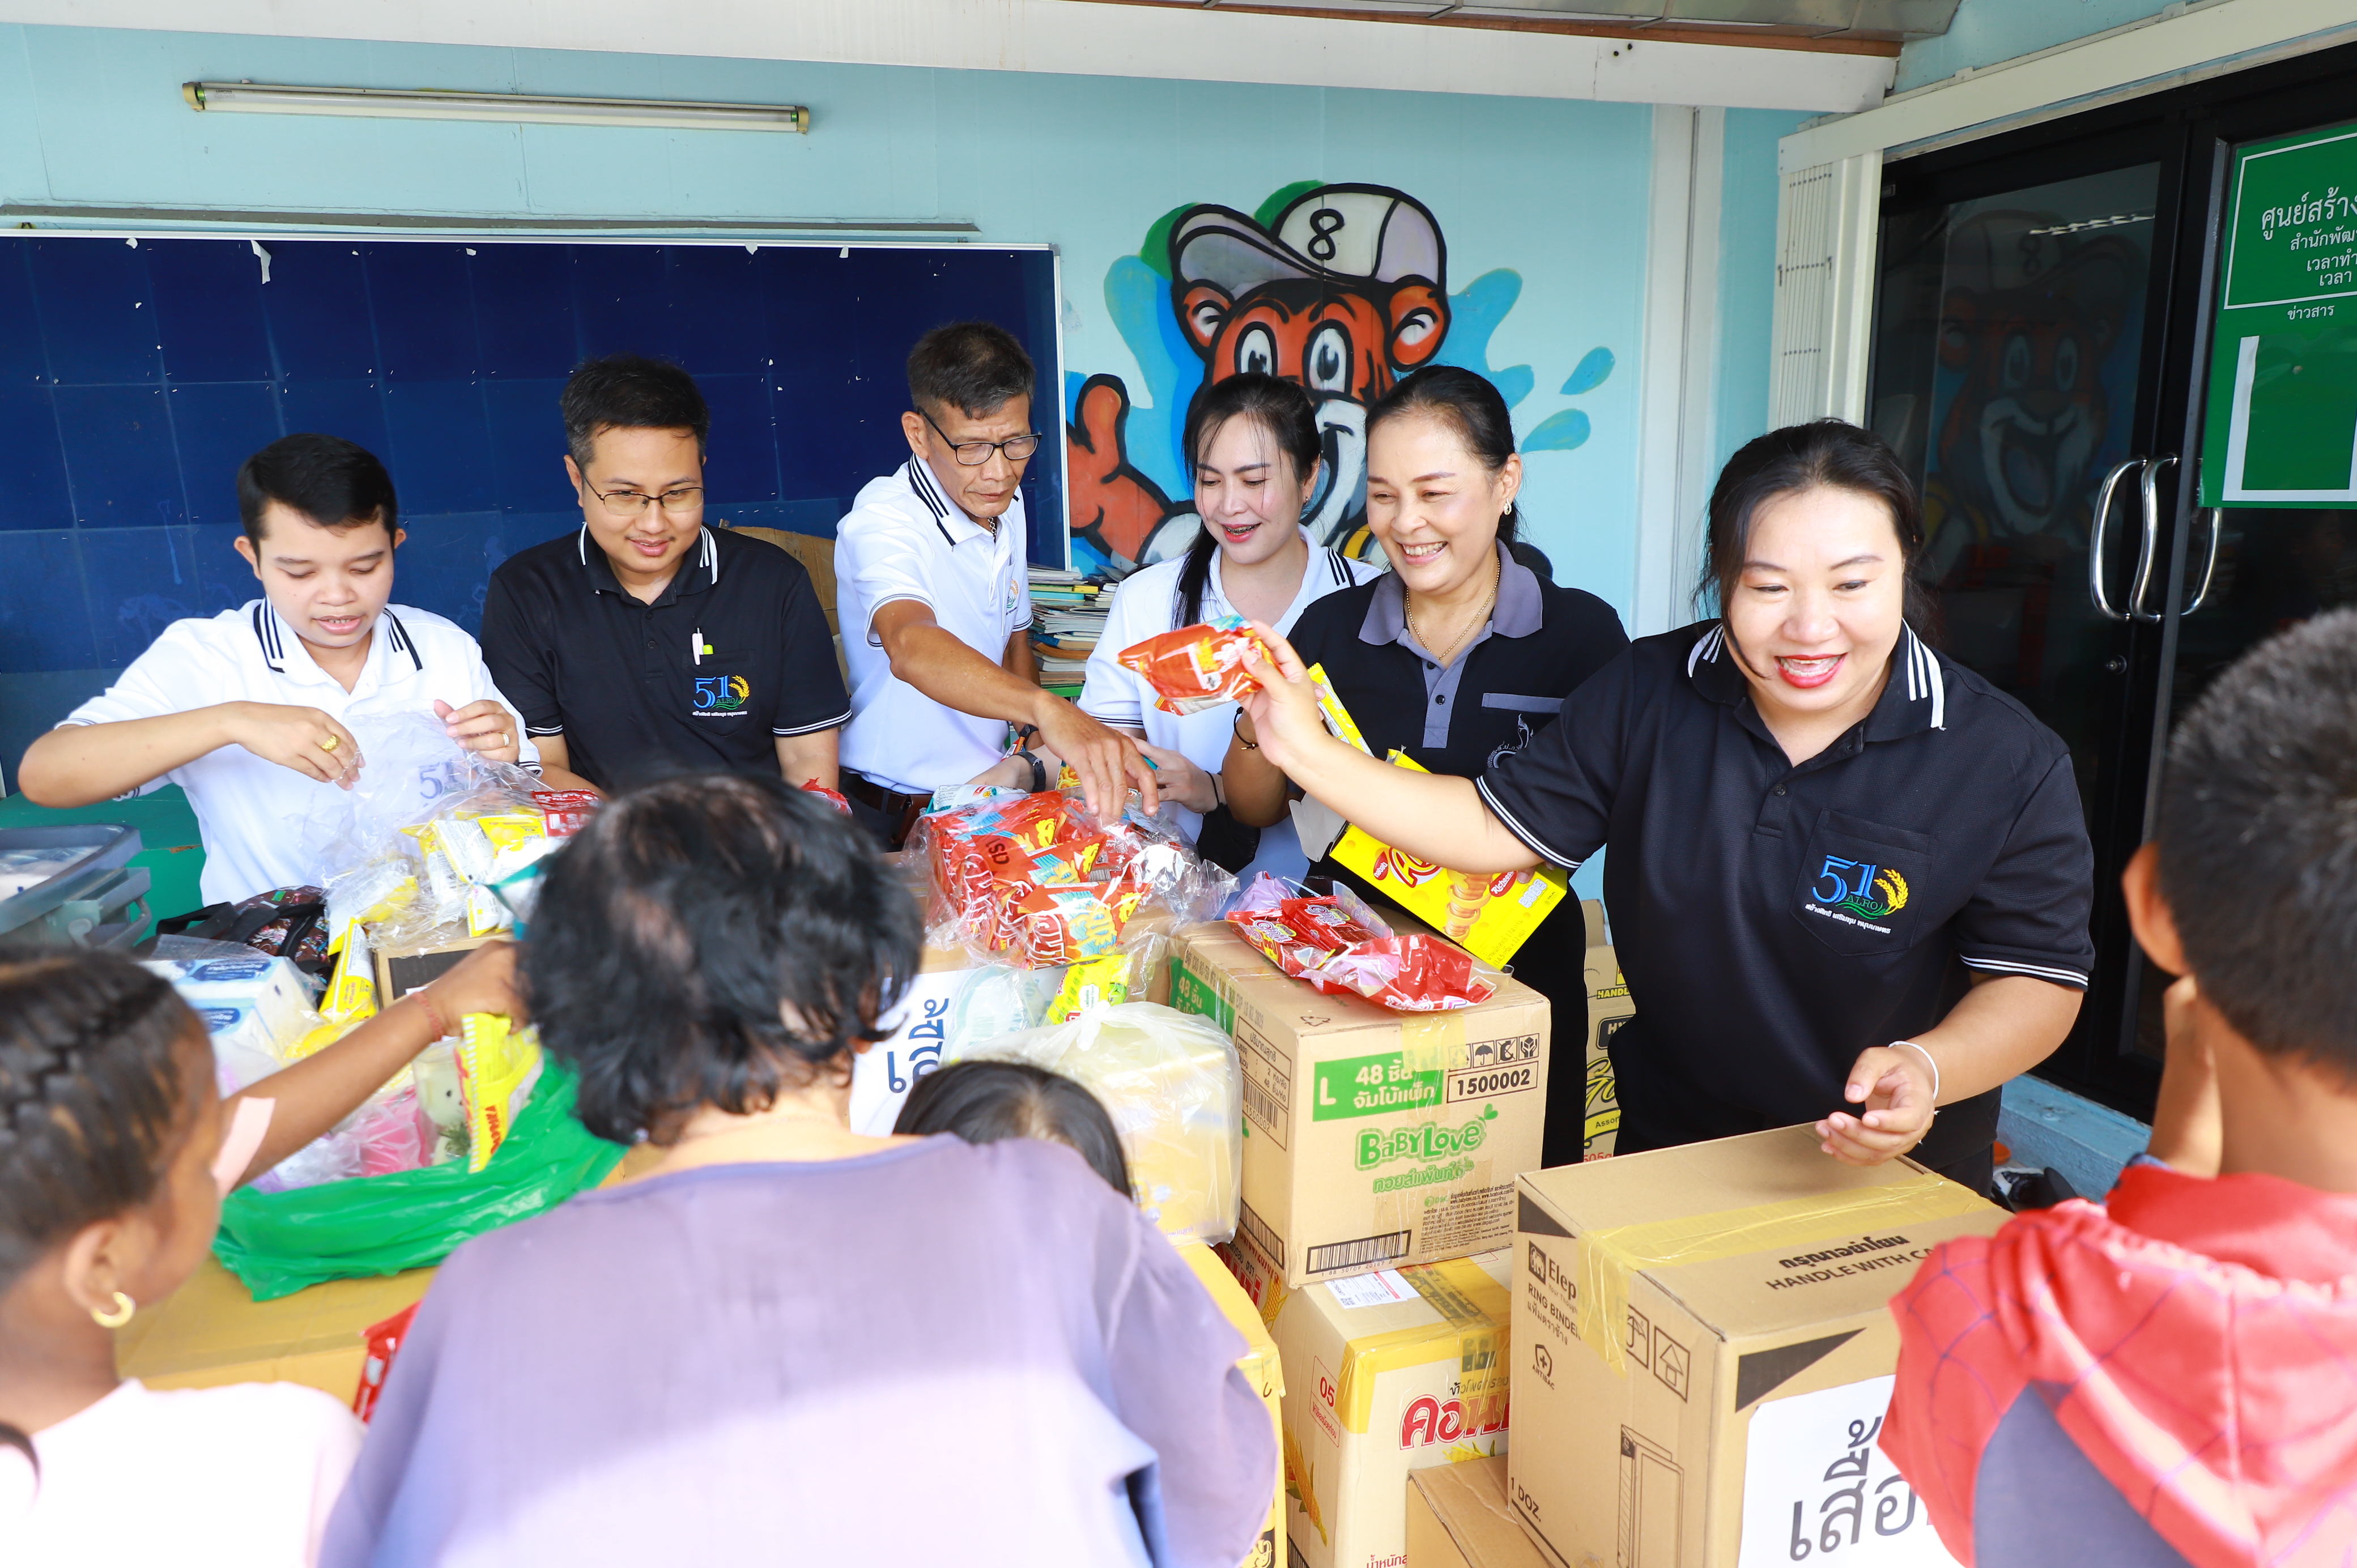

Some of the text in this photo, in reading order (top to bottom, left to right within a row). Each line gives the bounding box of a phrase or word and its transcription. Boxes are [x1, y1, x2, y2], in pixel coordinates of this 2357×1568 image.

[1308, 208, 1345, 261] 8
[2290, 225, 2357, 250] สำนักพัฒ
[2320, 270, 2352, 287] เวลา
[2287, 305, 2335, 320] ข่าวสาร
[694, 675, 733, 708] 51
[1813, 854, 1877, 904] 51
[1845, 894, 1878, 910] ALRO
[1178, 976, 1190, 998] 48
[1250, 1032, 1277, 1063] ปริมาณสุทธิ
[1239, 1053, 1249, 1070] ำนวน
[1264, 1077, 1270, 1088] 48
[1267, 1067, 1271, 1076] 2
[1355, 1064, 1383, 1085] 48
[1457, 1068, 1531, 1097] 1500002
[1320, 1077, 1337, 1106] L
[1353, 1081, 1436, 1109] จัมโบ้แพ็ก
[1246, 1105, 1271, 1134] 1500002
[1779, 1235, 1911, 1268] กรุณาอย่าโยน
[1341, 1266, 1360, 1274] 50709
[1765, 1248, 1934, 1290] HANDLE WITH CA
[1529, 1282, 1547, 1309] RING
[1560, 1292, 1578, 1314] Though
[1528, 1301, 1568, 1345] แฟ้มตราช้าง
[1533, 1364, 1555, 1390] ANTIBAC
[1320, 1376, 1335, 1408] 05
[1511, 1476, 1542, 1522] 1 DOZ.
[1788, 1416, 1917, 1562] เสื้อ
